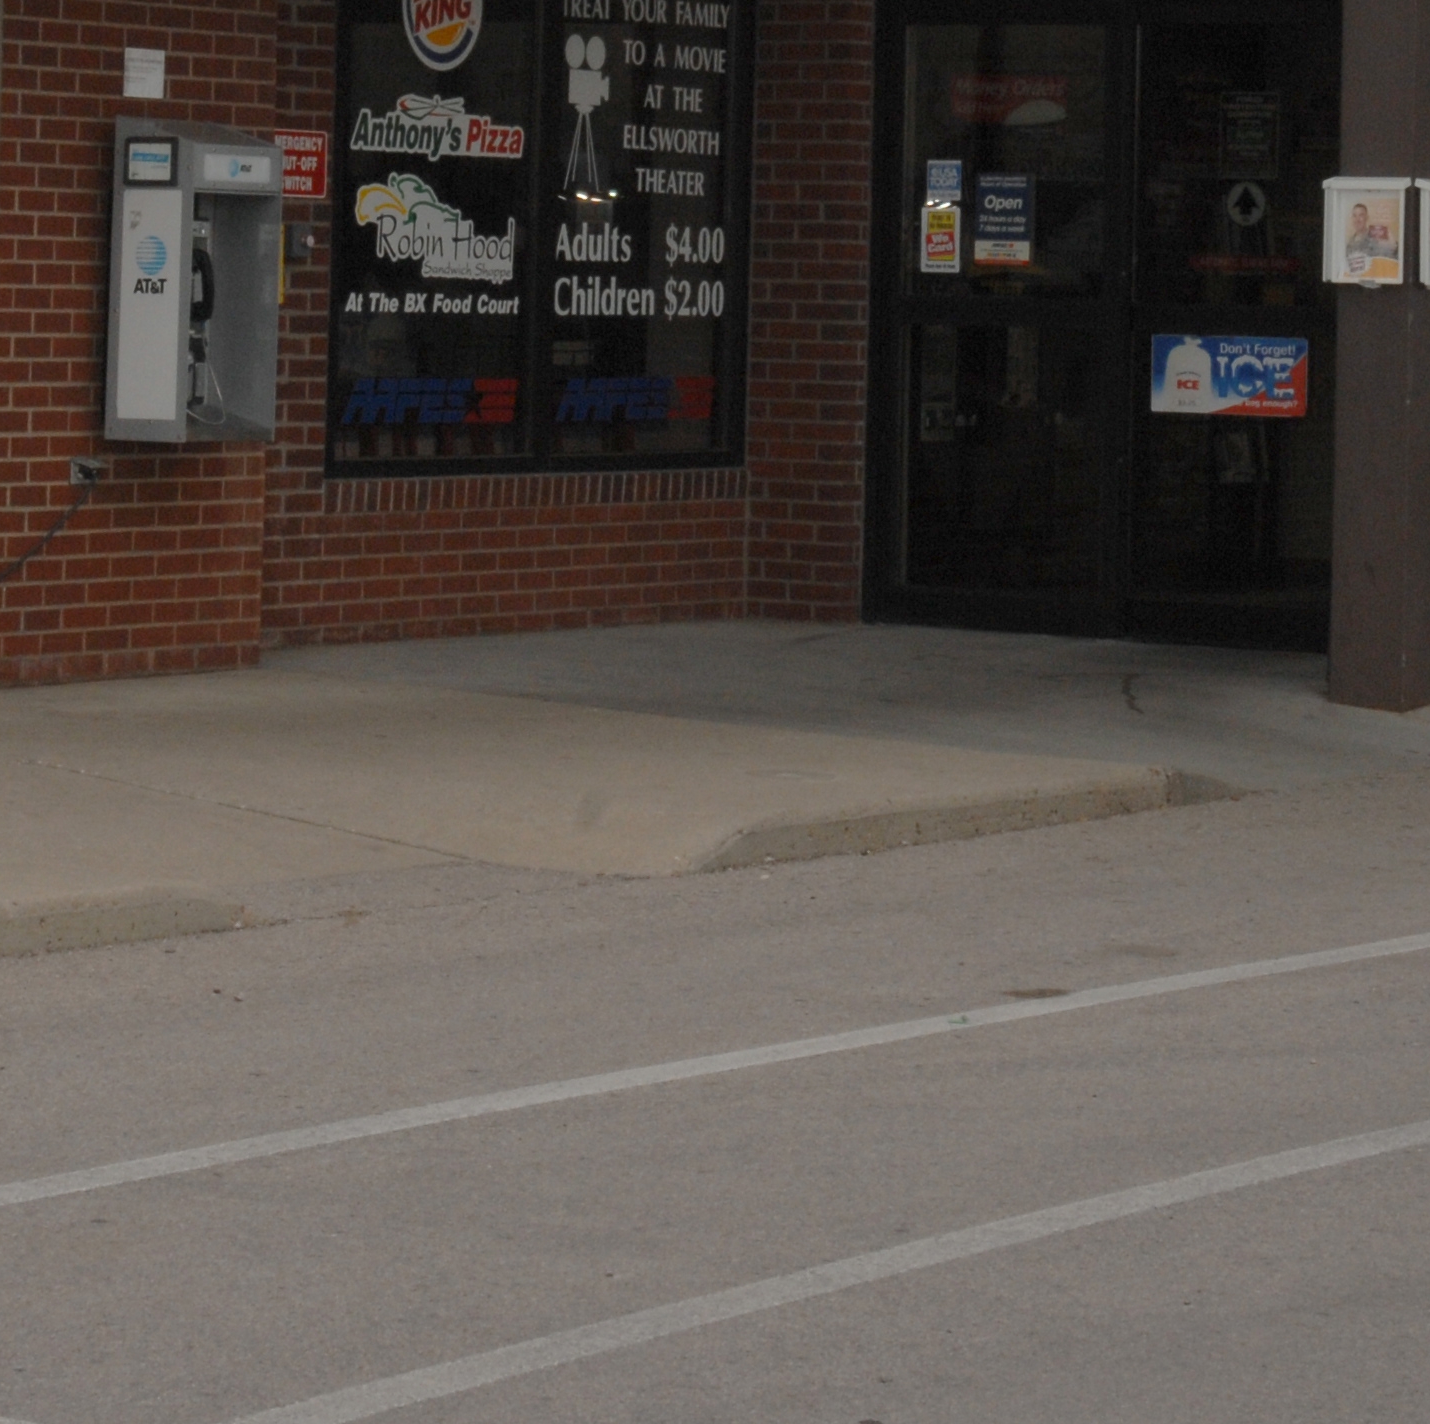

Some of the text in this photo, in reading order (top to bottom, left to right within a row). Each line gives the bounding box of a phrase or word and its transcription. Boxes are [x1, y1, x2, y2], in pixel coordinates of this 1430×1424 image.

[675, 1, 730, 28] FAMILY
[623, 39, 727, 74] TO A MOVIE
[644, 84, 703, 112] AT THE
[275, 135, 323, 152] MERGENCY
[354, 113, 521, 157] Anthony's Pizza
[623, 126, 720, 156] ELLSWORTH
[283, 156, 318, 171] UT-OFF
[283, 176, 313, 191] WITCH
[635, 168, 704, 196] THEATER
[984, 195, 1023, 212] Open
[377, 214, 513, 262] Robin Hood
[555, 222, 725, 268] Adults $4.00
[928, 242, 953, 253] Card
[133, 278, 168, 294] AT&T
[554, 275, 724, 321] Children $2.00
[345, 292, 520, 315] At The BX Food Court
[1220, 342, 1296, 357] Don't Forget!
[1176, 379, 1200, 390] ICE
[1216, 354, 1295, 399] ICE
